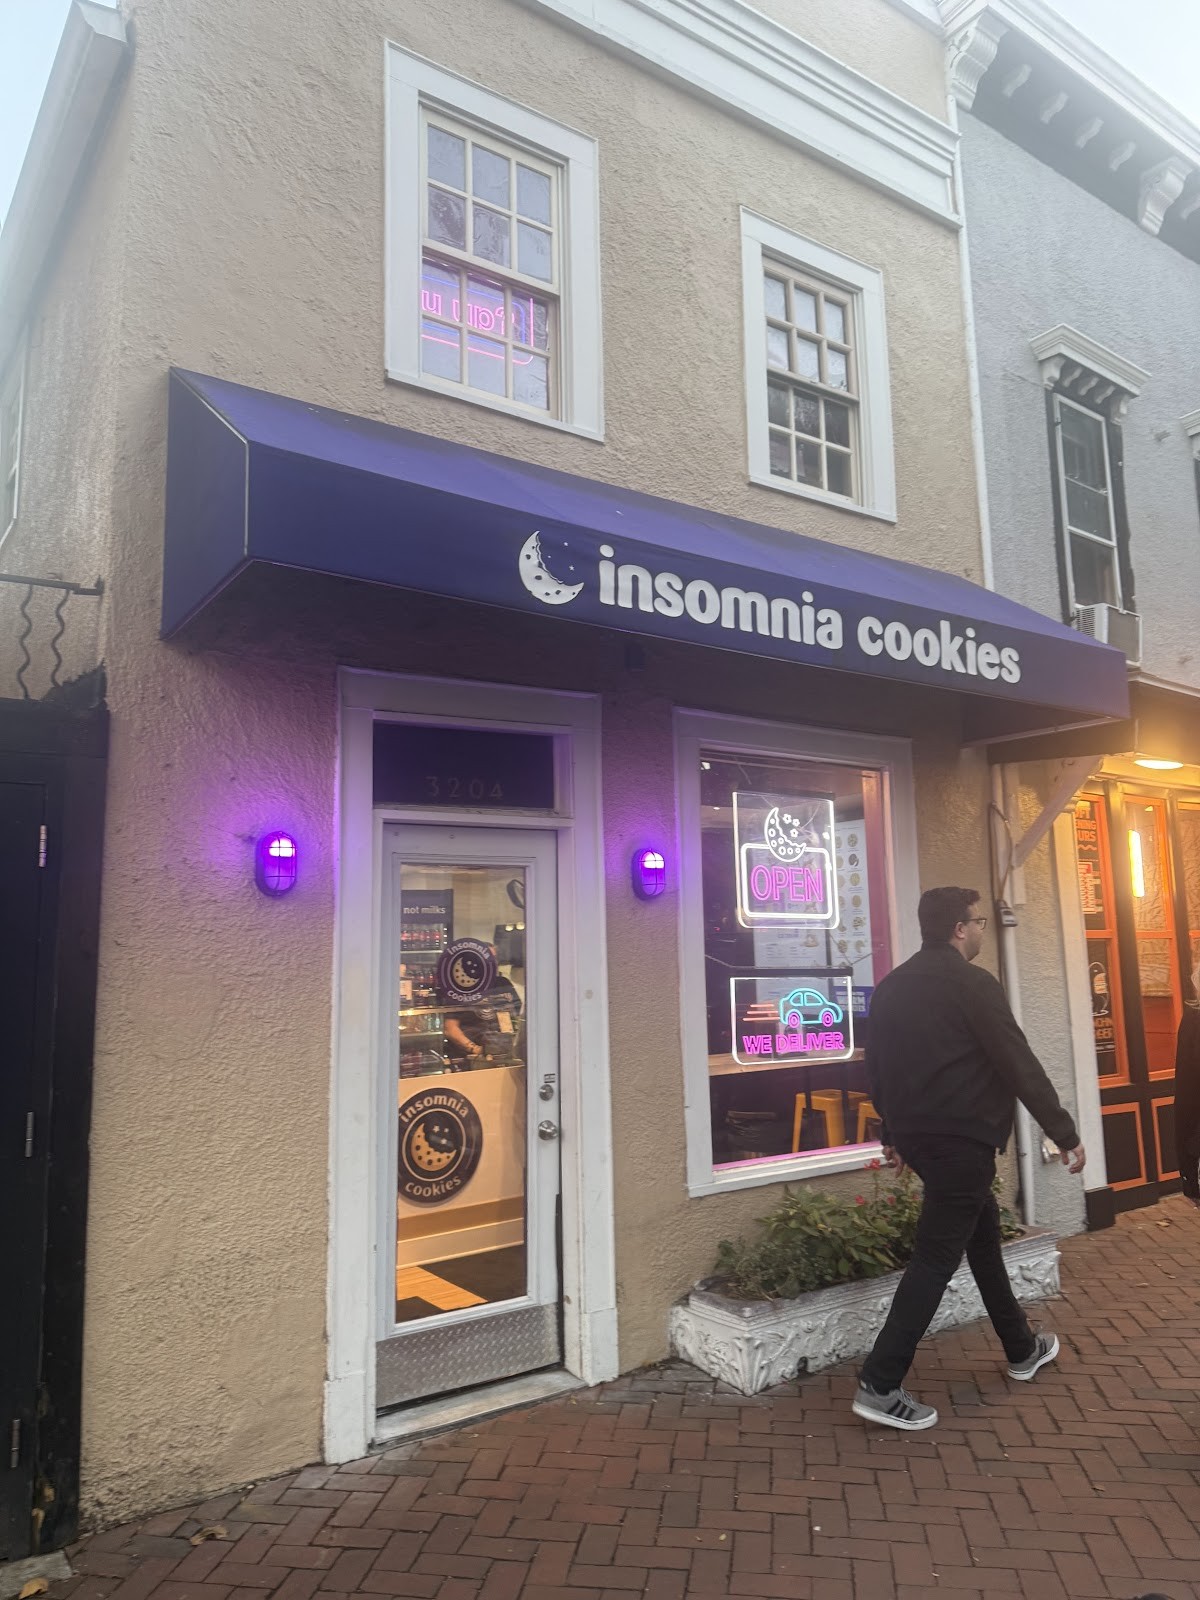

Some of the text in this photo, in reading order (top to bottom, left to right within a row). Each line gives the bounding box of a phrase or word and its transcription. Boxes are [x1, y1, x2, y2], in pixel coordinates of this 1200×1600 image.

[599, 544, 1022, 684] insomnia cookies
[425, 776, 504, 799] 3204
[750, 864, 824, 902] OPEN
[403, 906, 420, 914] not
[447, 941, 490, 960] insomnia
[447, 990, 482, 1002] cookies
[742, 1031, 846, 1055] WE DELIVER
[399, 1094, 470, 1123] insomnia
[405, 1175, 461, 1197] cookies
